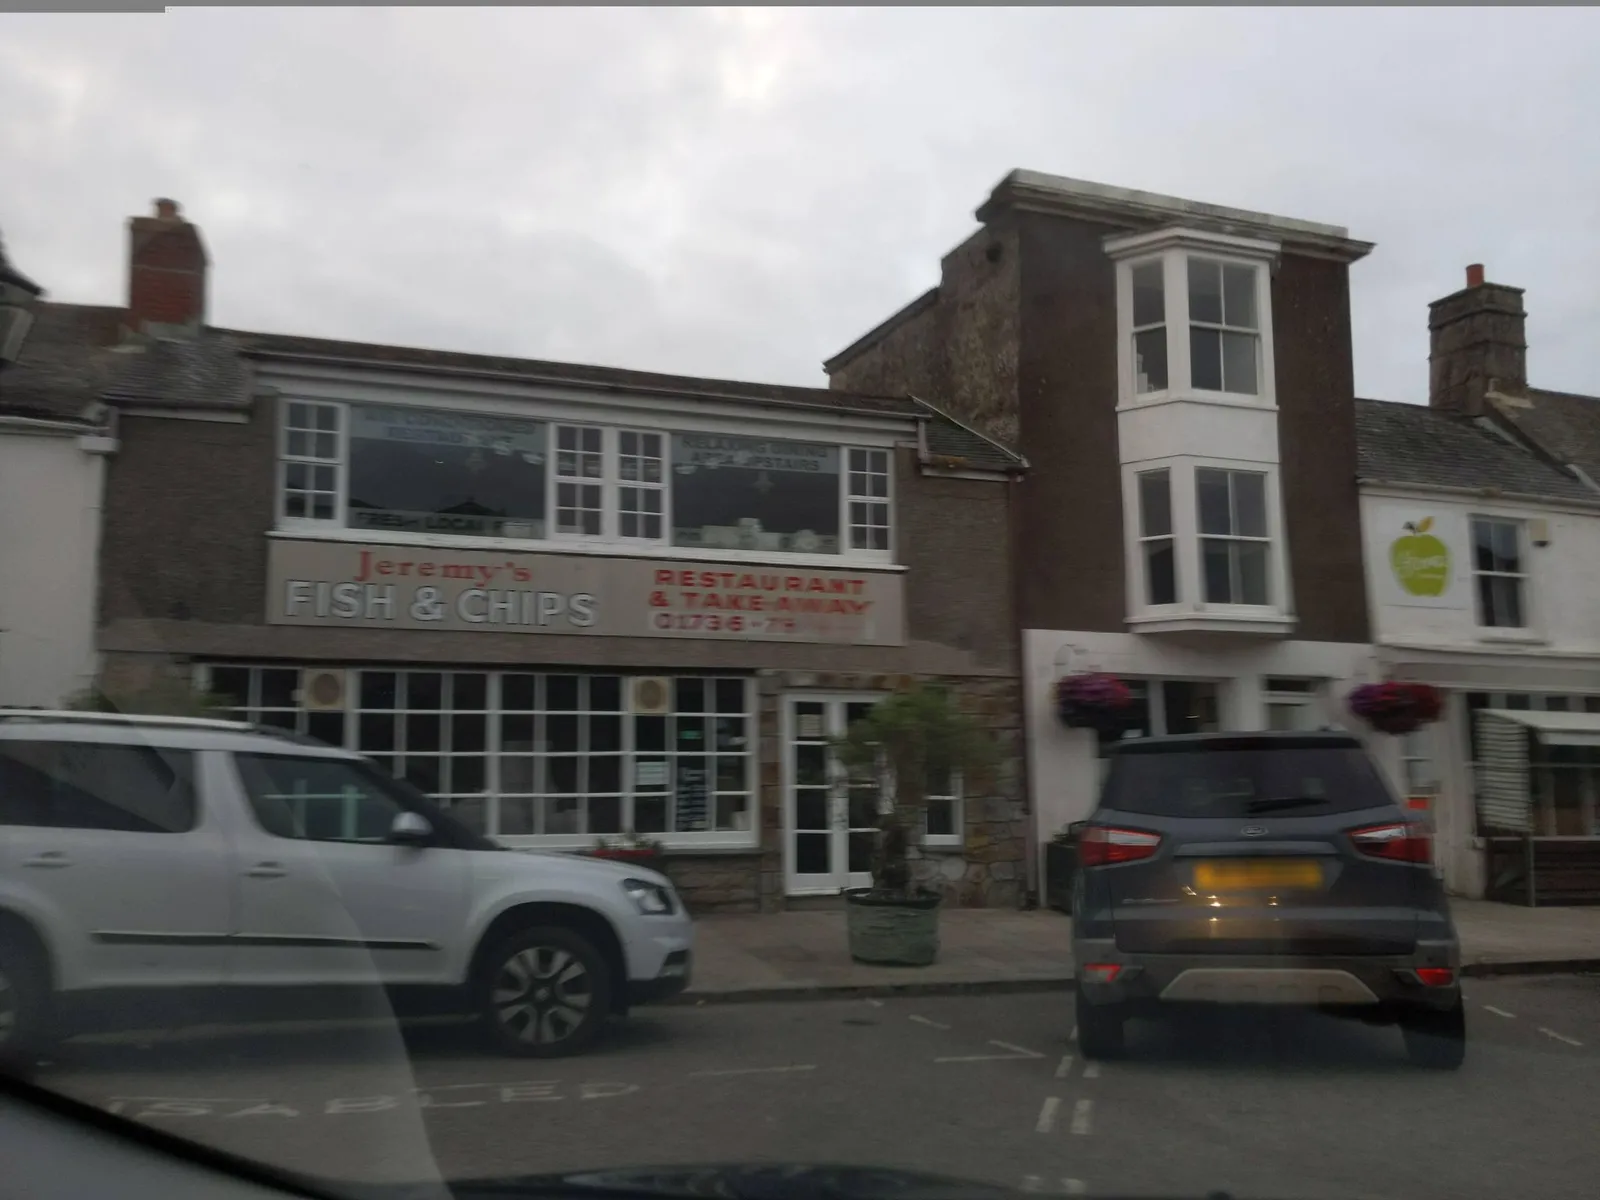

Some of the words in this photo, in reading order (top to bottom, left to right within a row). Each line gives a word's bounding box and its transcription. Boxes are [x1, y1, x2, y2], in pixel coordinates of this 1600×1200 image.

[354, 550, 532, 587] Jeremy's
[654, 569, 866, 595] RESTAURANT
[284, 579, 396, 620] FISH
[409, 585, 446, 622] &
[457, 588, 597, 627] CHIPS
[649, 591, 669, 607] &
[105, 1083, 640, 1116] ISABLED
